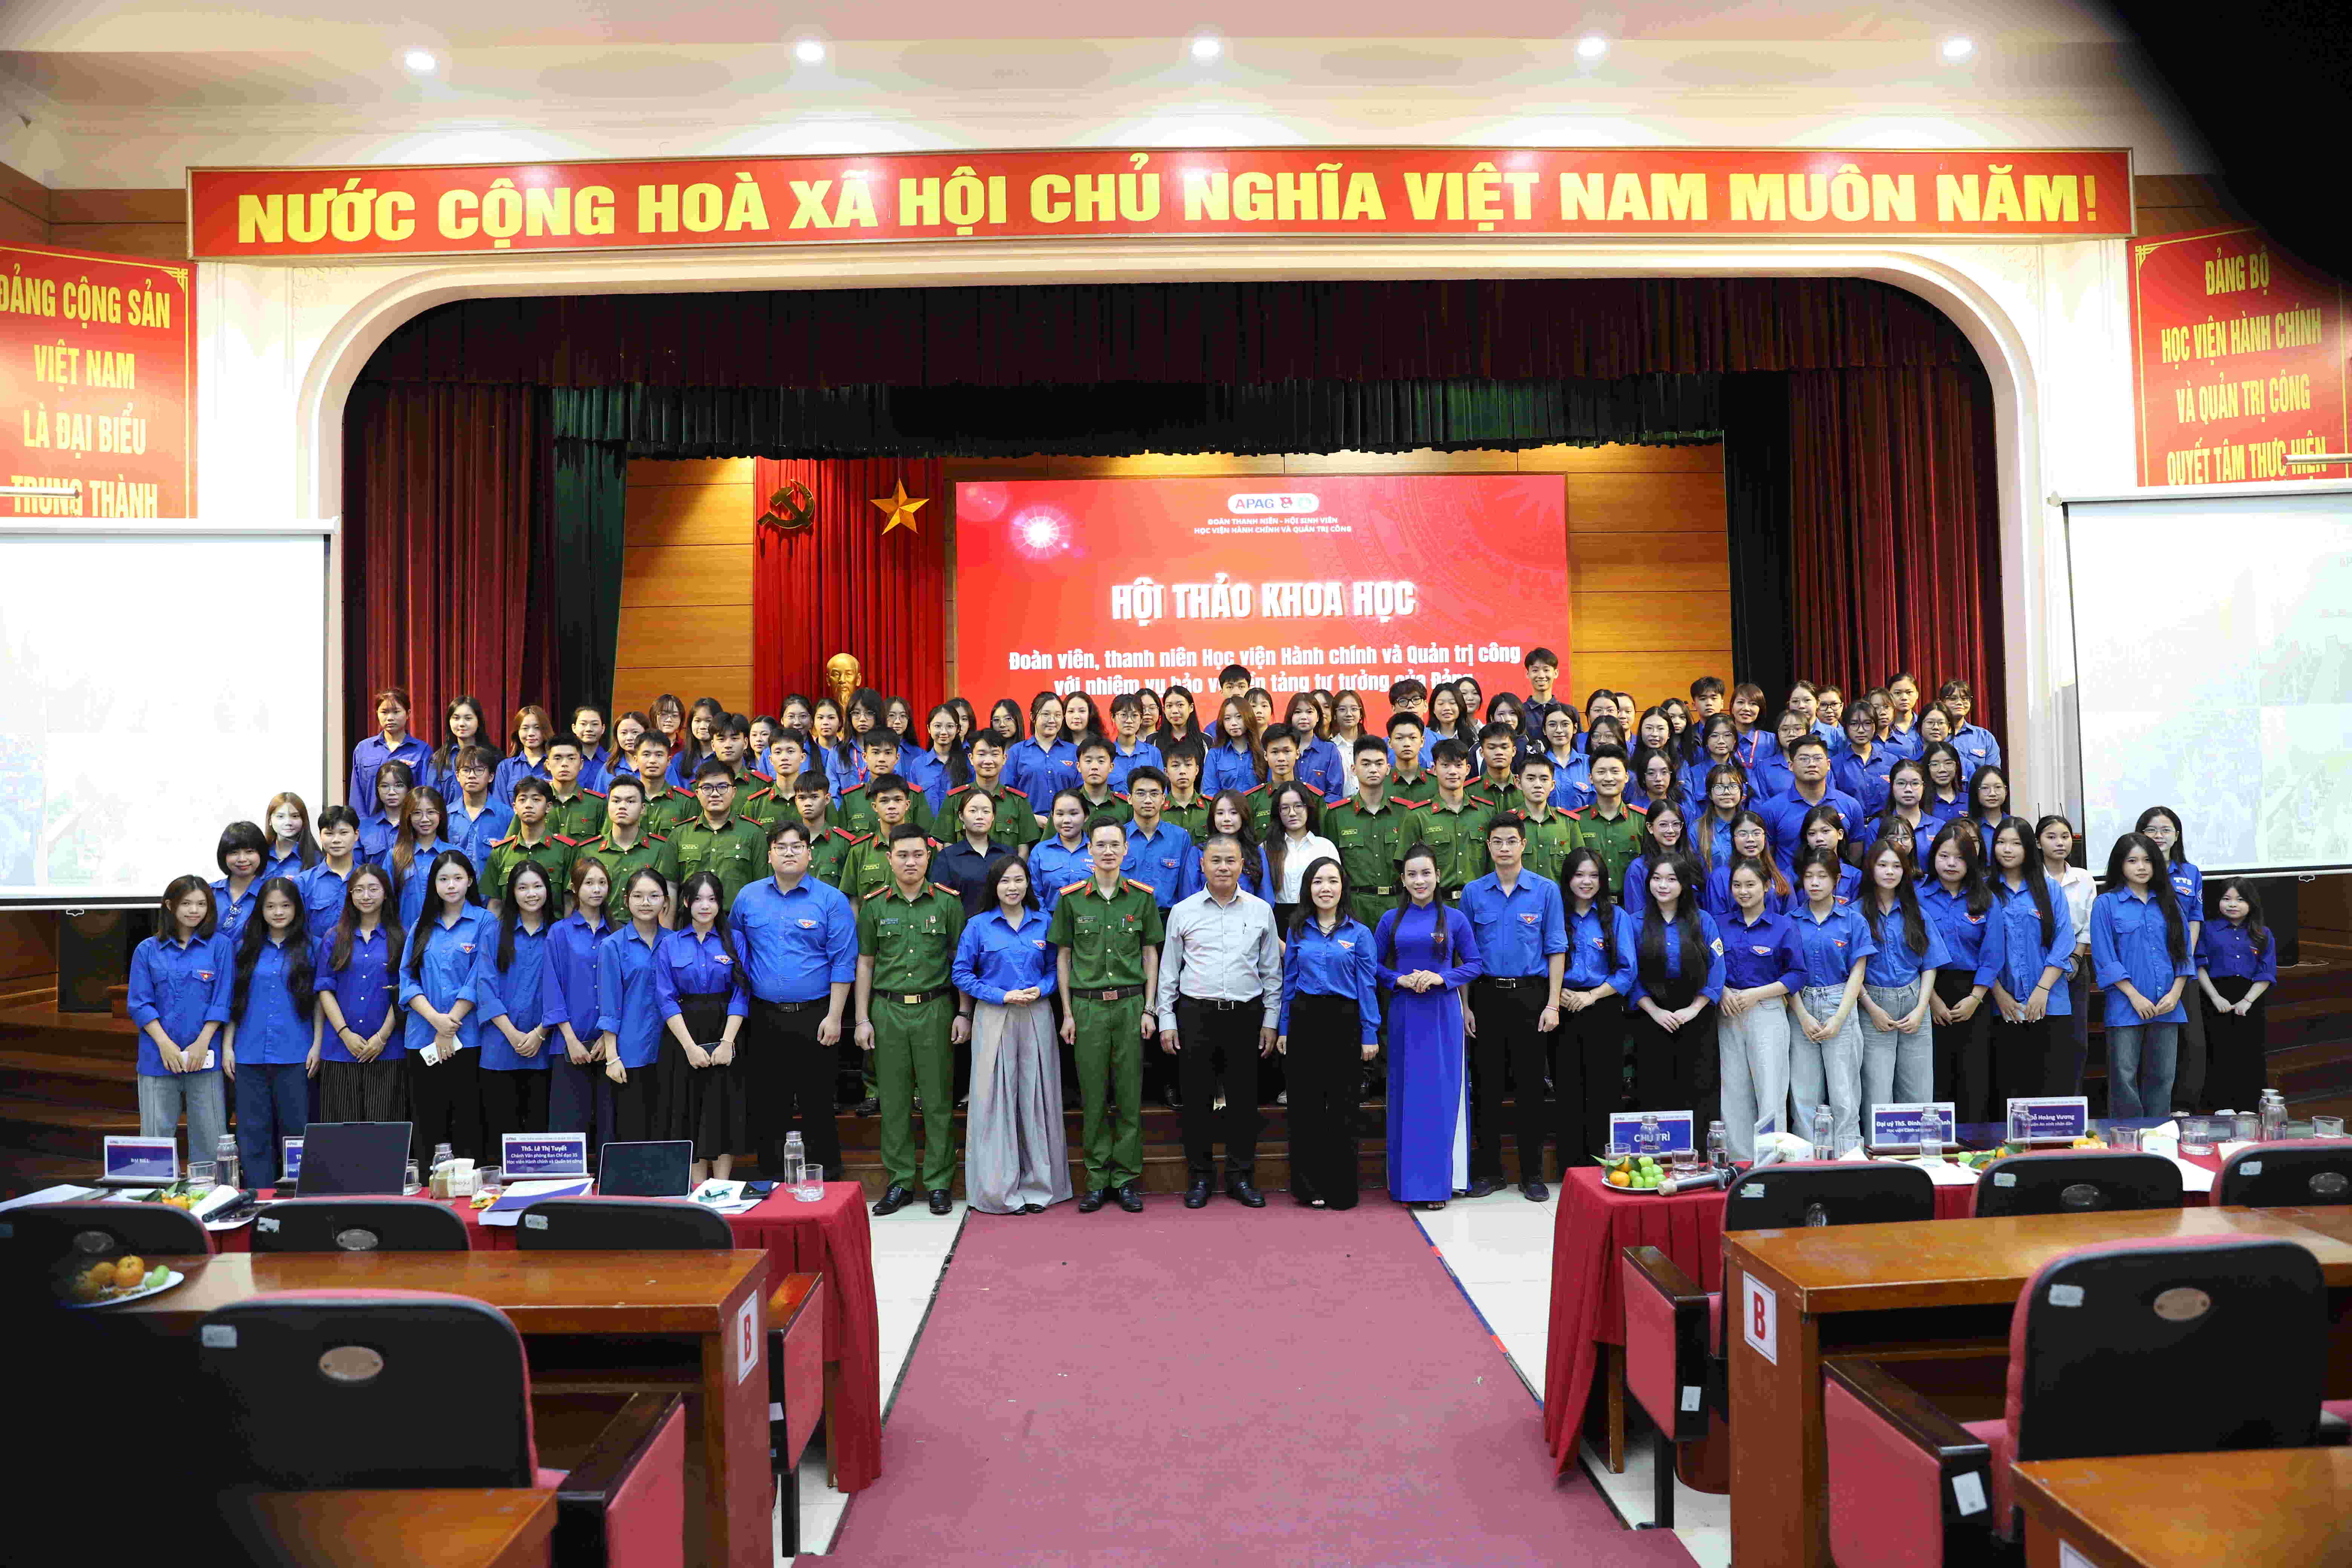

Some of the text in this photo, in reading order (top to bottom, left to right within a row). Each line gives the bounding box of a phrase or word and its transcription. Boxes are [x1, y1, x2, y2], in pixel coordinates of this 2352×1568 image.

[238, 153, 2097, 249] NƯỚC CỘNG HOÀ XÃ HỘI CHỦ NGHĨA VIỆT NAM MUÔN NĂM!
[0, 263, 170, 329] ĐẢNG CỘNG SẢN
[2205, 244, 2270, 296] ĐẢNG BỘ
[2161, 302, 2322, 370] HỌC VIỆN HÀNH CHÍNH
[34, 339, 135, 392] VIỆT NAM
[2175, 369, 2310, 425] VÀ QUẢN TRỊ CÔNG
[24, 402, 146, 459] LÀ ĐẠI BIỂU
[2167, 436, 2210, 485] QUYẾT
[2213, 438, 2245, 482] TÂM
[89, 473, 158, 518] THÀNH
[1236, 498, 1274, 509] APAG
[1112, 573, 1417, 626] HỘI THẢO KHOA HỌC
[1009, 642, 1521, 671] Đoàn viên, thanh niên Học viện Hành chính và Quản trị công
[1054, 675, 1080, 696] với
[1271, 671, 1309, 693] tảng
[1314, 674, 1334, 691] tư
[1338, 669, 1389, 692] tưởng
[744, 1314, 751, 1362] B
[1753, 1291, 1765, 1340] B
